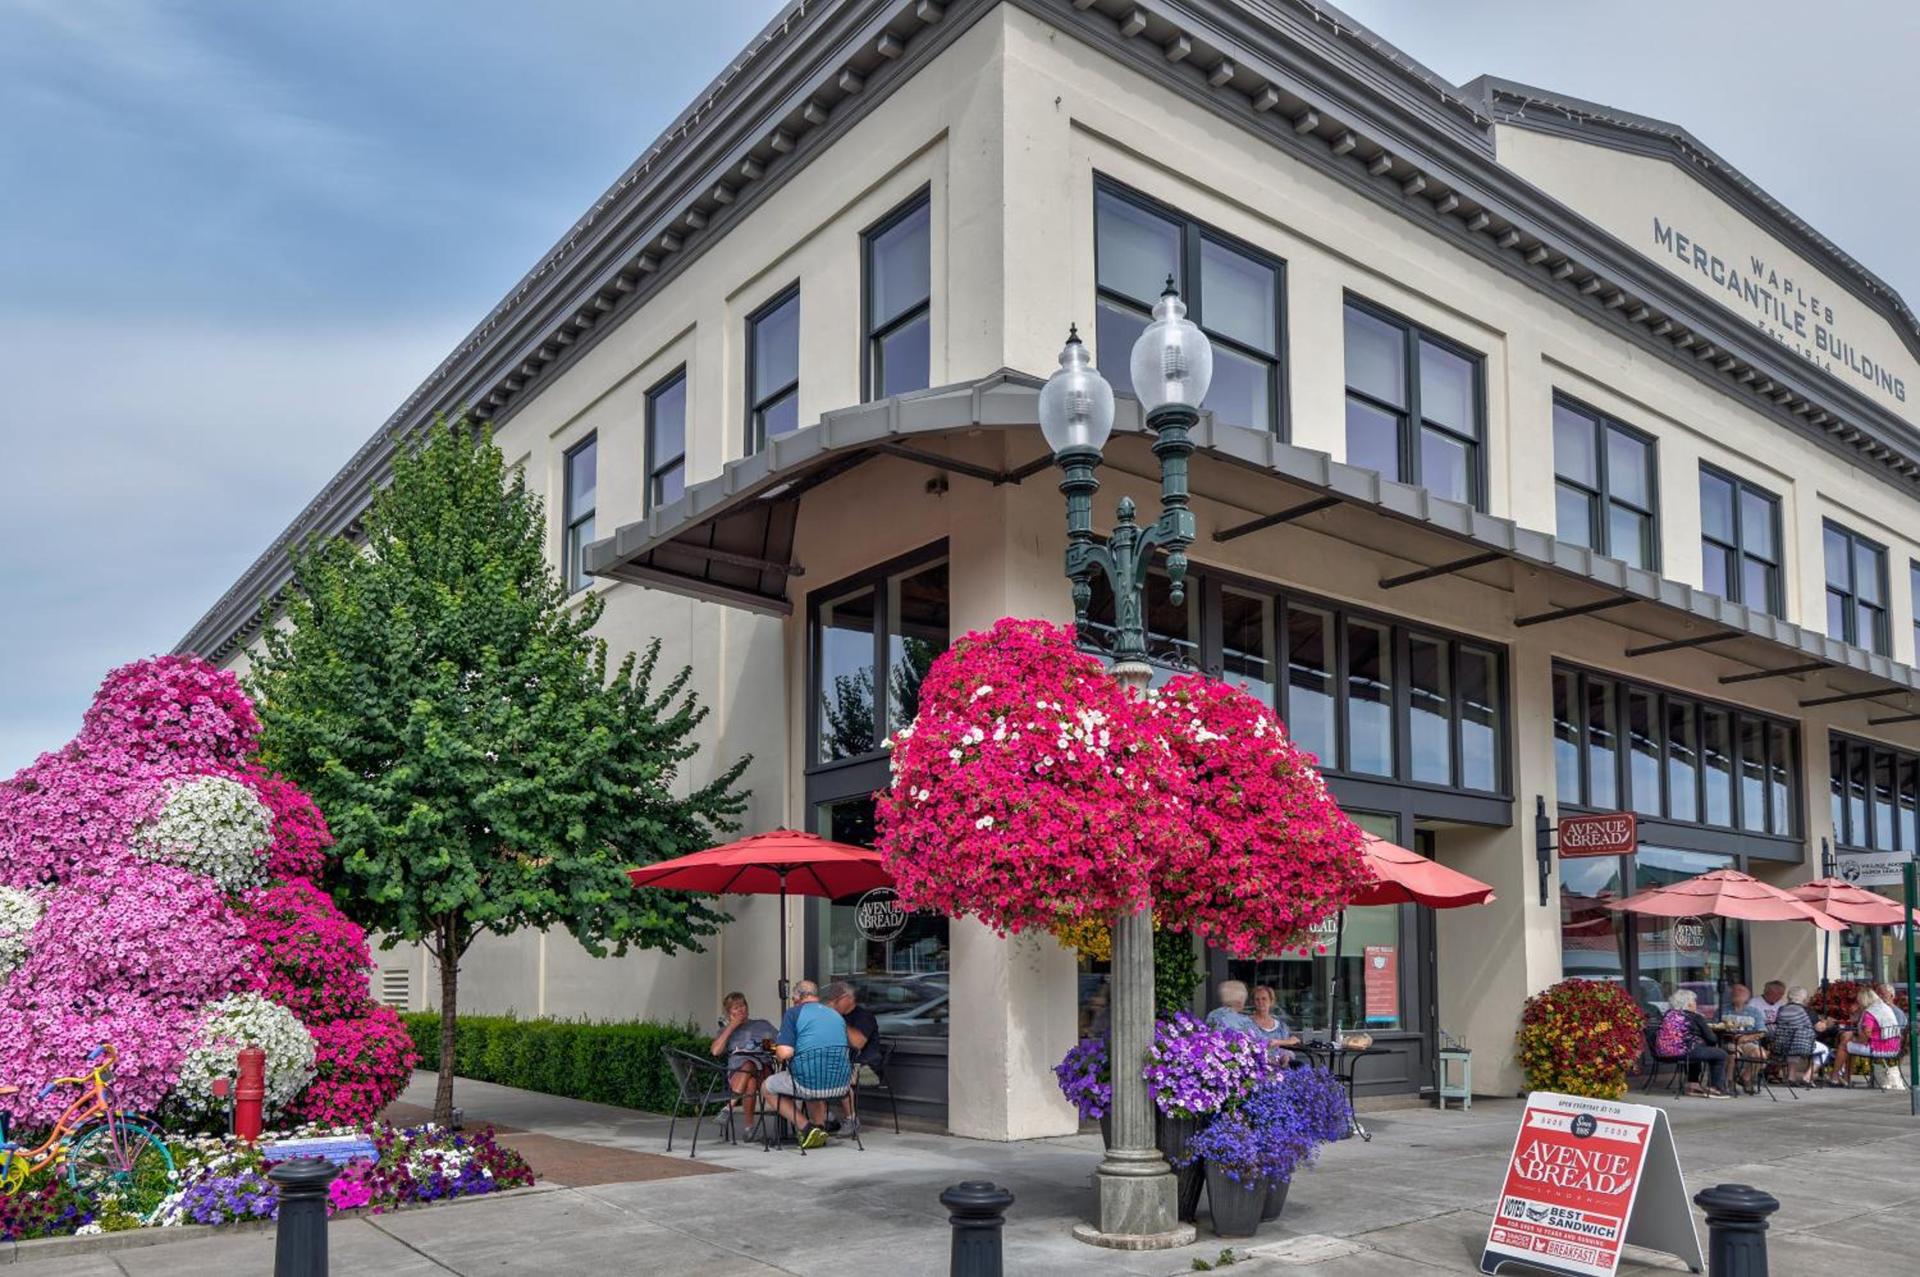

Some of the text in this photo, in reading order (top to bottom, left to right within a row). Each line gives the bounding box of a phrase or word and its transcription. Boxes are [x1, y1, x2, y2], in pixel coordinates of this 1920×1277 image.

[1750, 255, 1834, 326] WAPLES
[1653, 216, 1906, 402] MERCANTILE BUILDING
[1566, 820, 1627, 837] AVENUE
[1571, 832, 1623, 847] BREAD
[864, 913, 898, 930] BREAD
[1521, 1139, 1630, 1176] AVENUE
[1525, 1160, 1617, 1194] BREAD
[1550, 1207, 1582, 1221] BEST
[1548, 1216, 1616, 1238] SANDWICH
[1549, 1242, 1594, 1264] BREAKFAST
